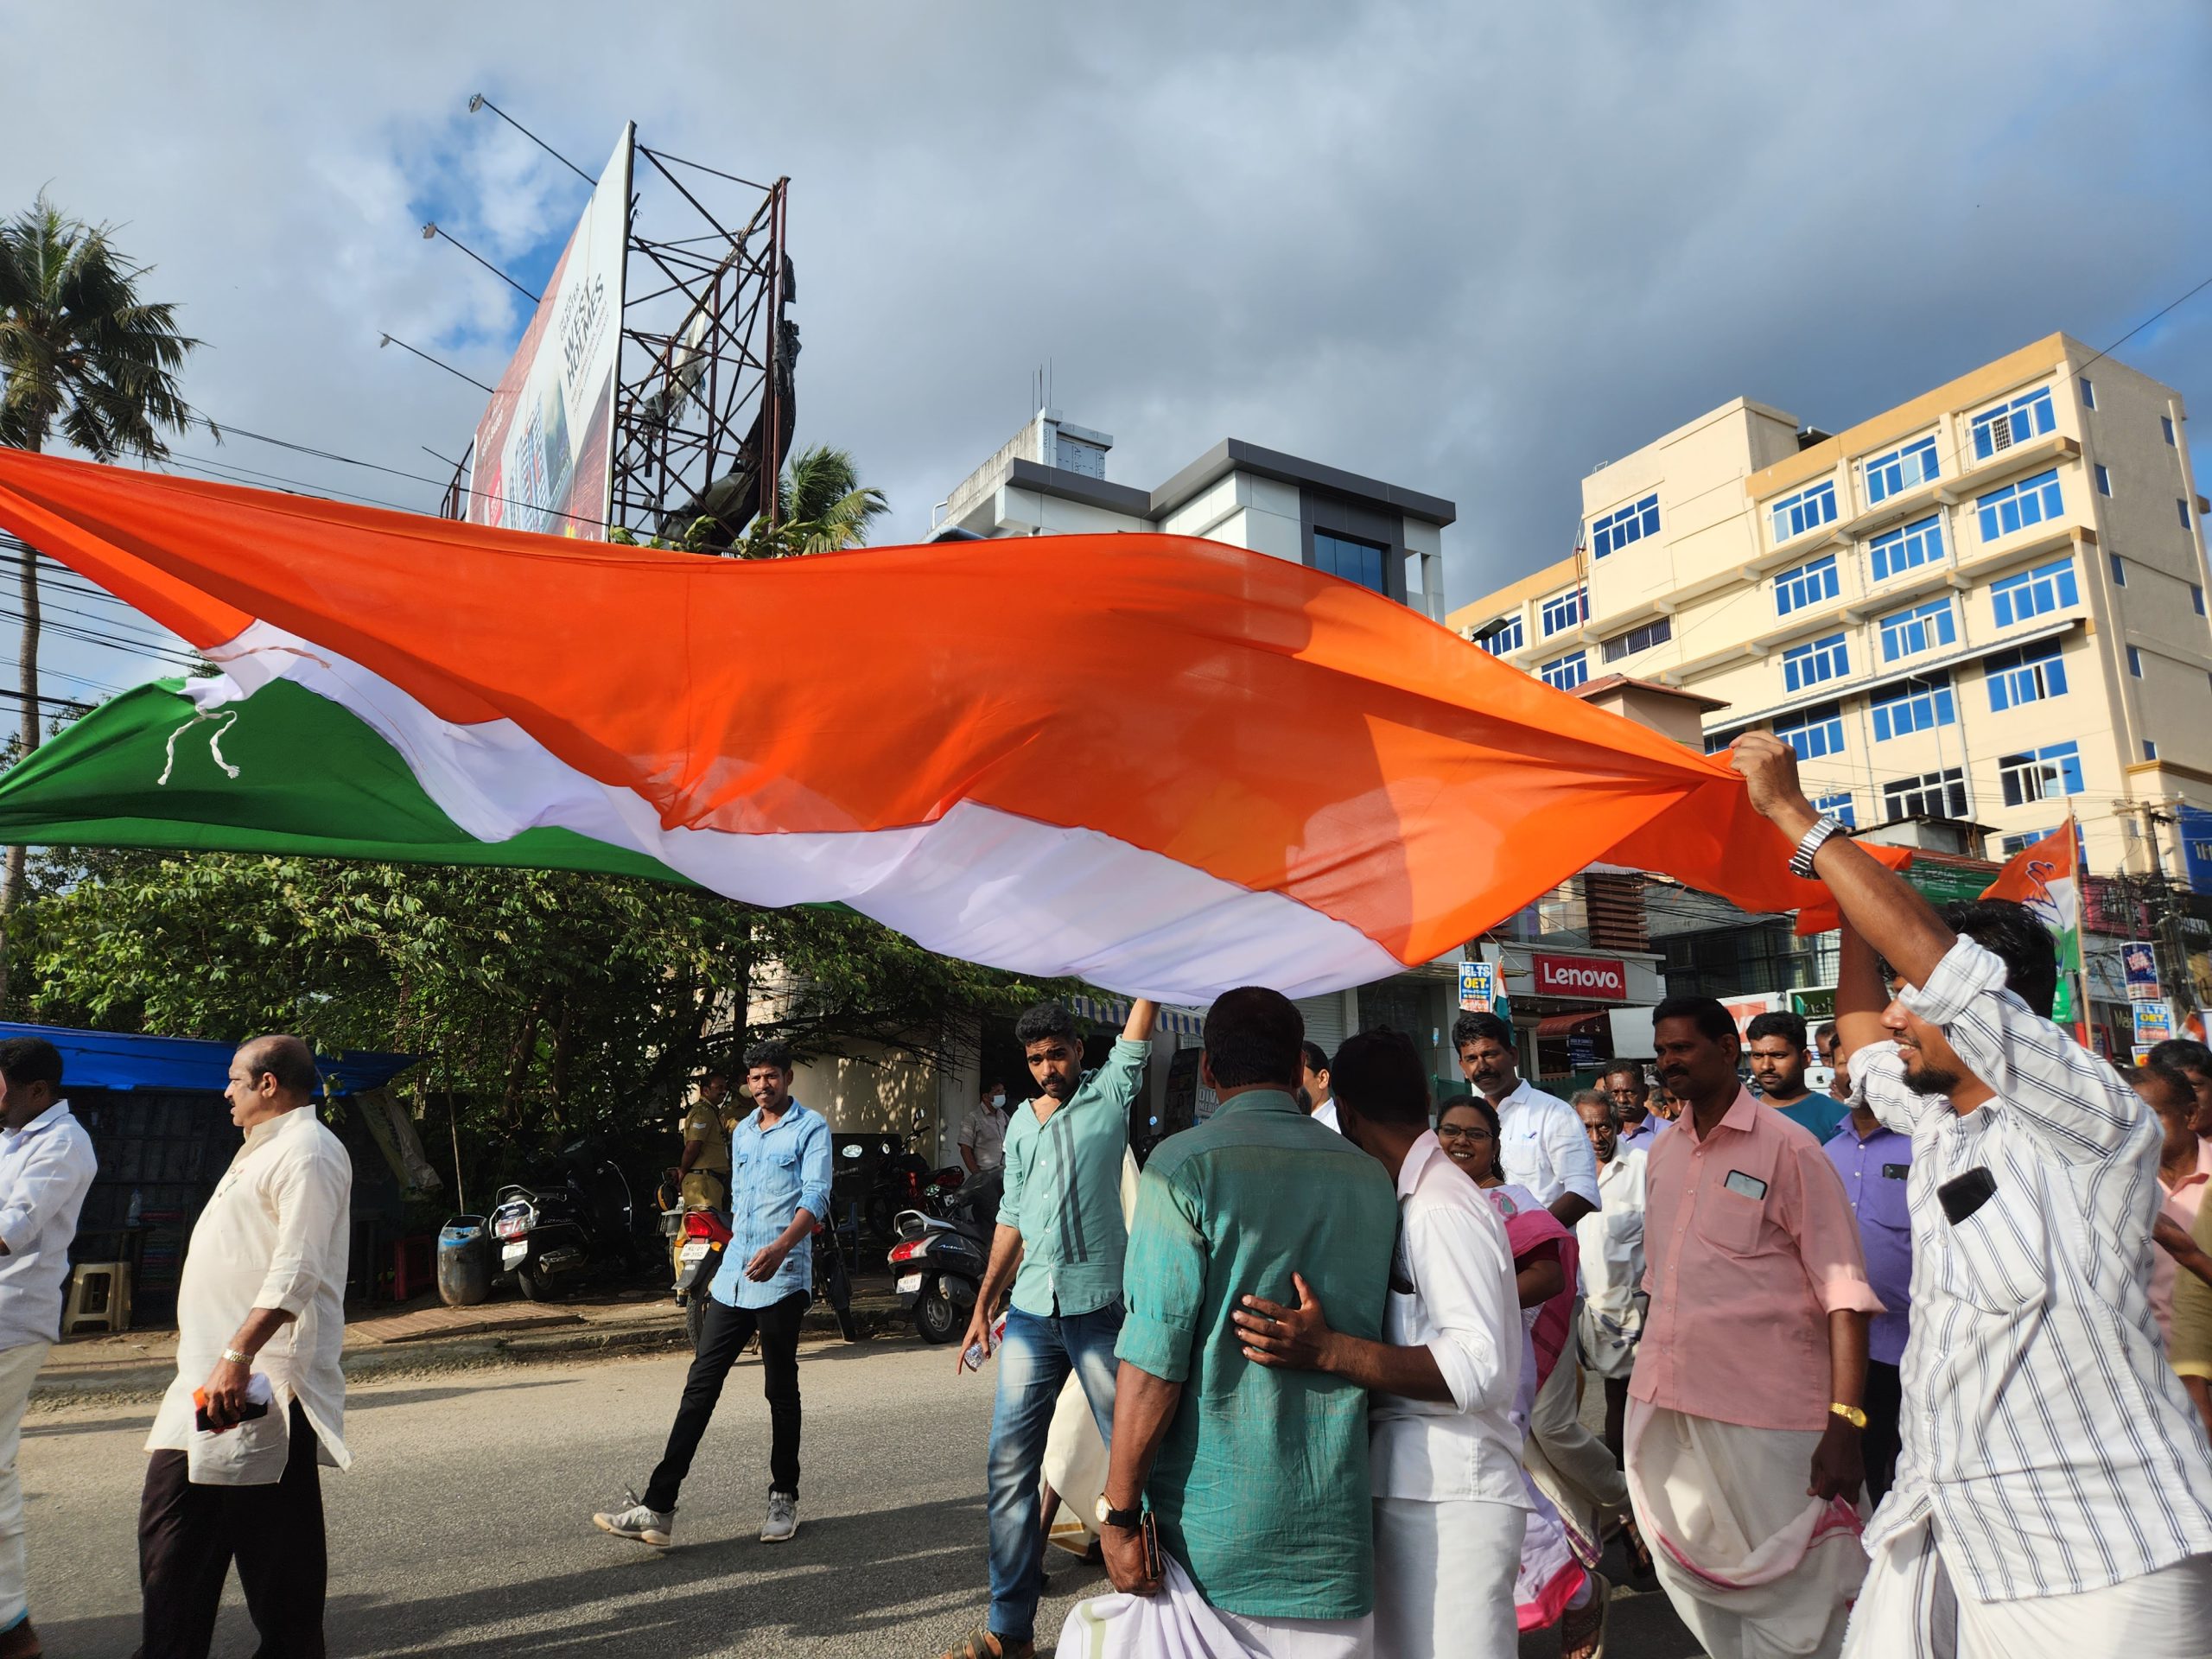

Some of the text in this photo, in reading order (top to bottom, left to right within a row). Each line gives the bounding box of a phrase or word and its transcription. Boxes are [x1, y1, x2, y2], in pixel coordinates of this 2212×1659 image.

[564, 276, 590, 362] WEST
[567, 273, 604, 388] HOLMES
[1461, 965, 1491, 977] IELTS
[1544, 963, 1618, 988] Lenovo
[2135, 1005, 2167, 1014] IELTS
